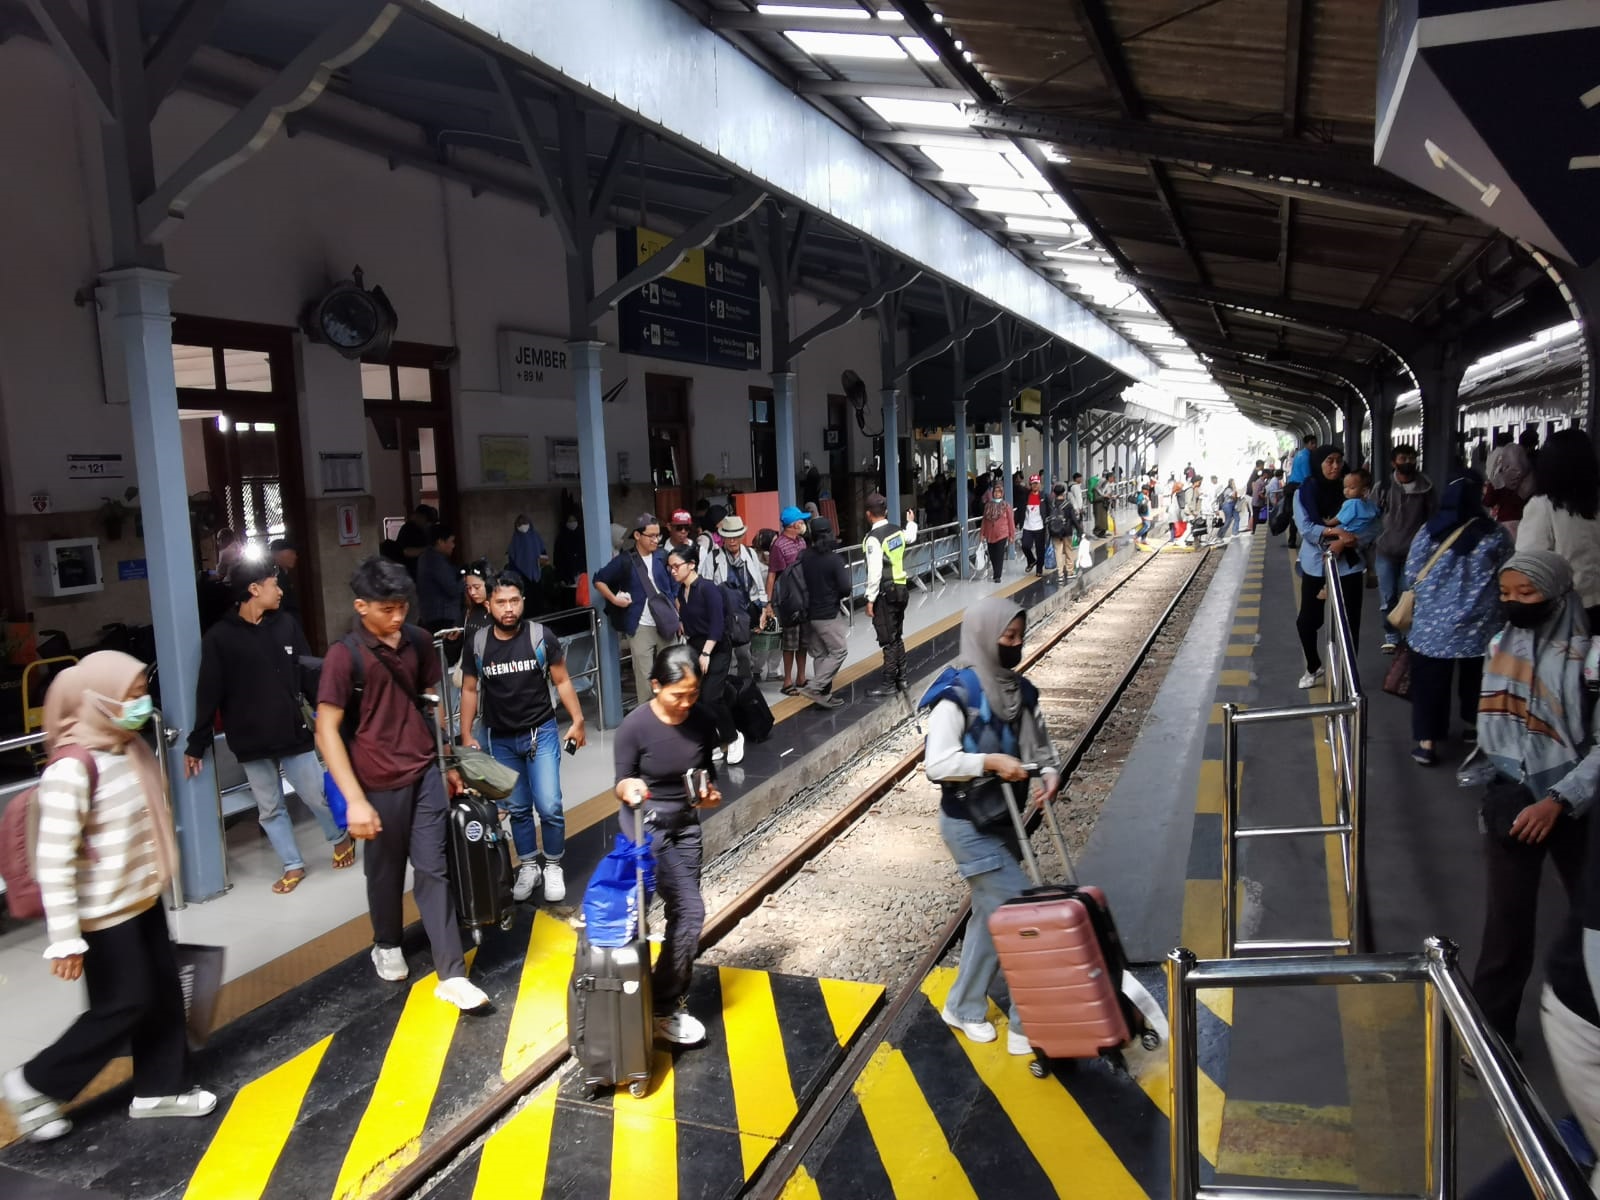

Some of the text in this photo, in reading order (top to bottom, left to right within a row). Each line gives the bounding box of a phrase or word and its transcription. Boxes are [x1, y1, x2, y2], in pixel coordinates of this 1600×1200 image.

[515, 346, 567, 369] JEMBER
[523, 371, 534, 382] 89
[535, 372, 544, 382] M
[87, 464, 104, 473] 121
